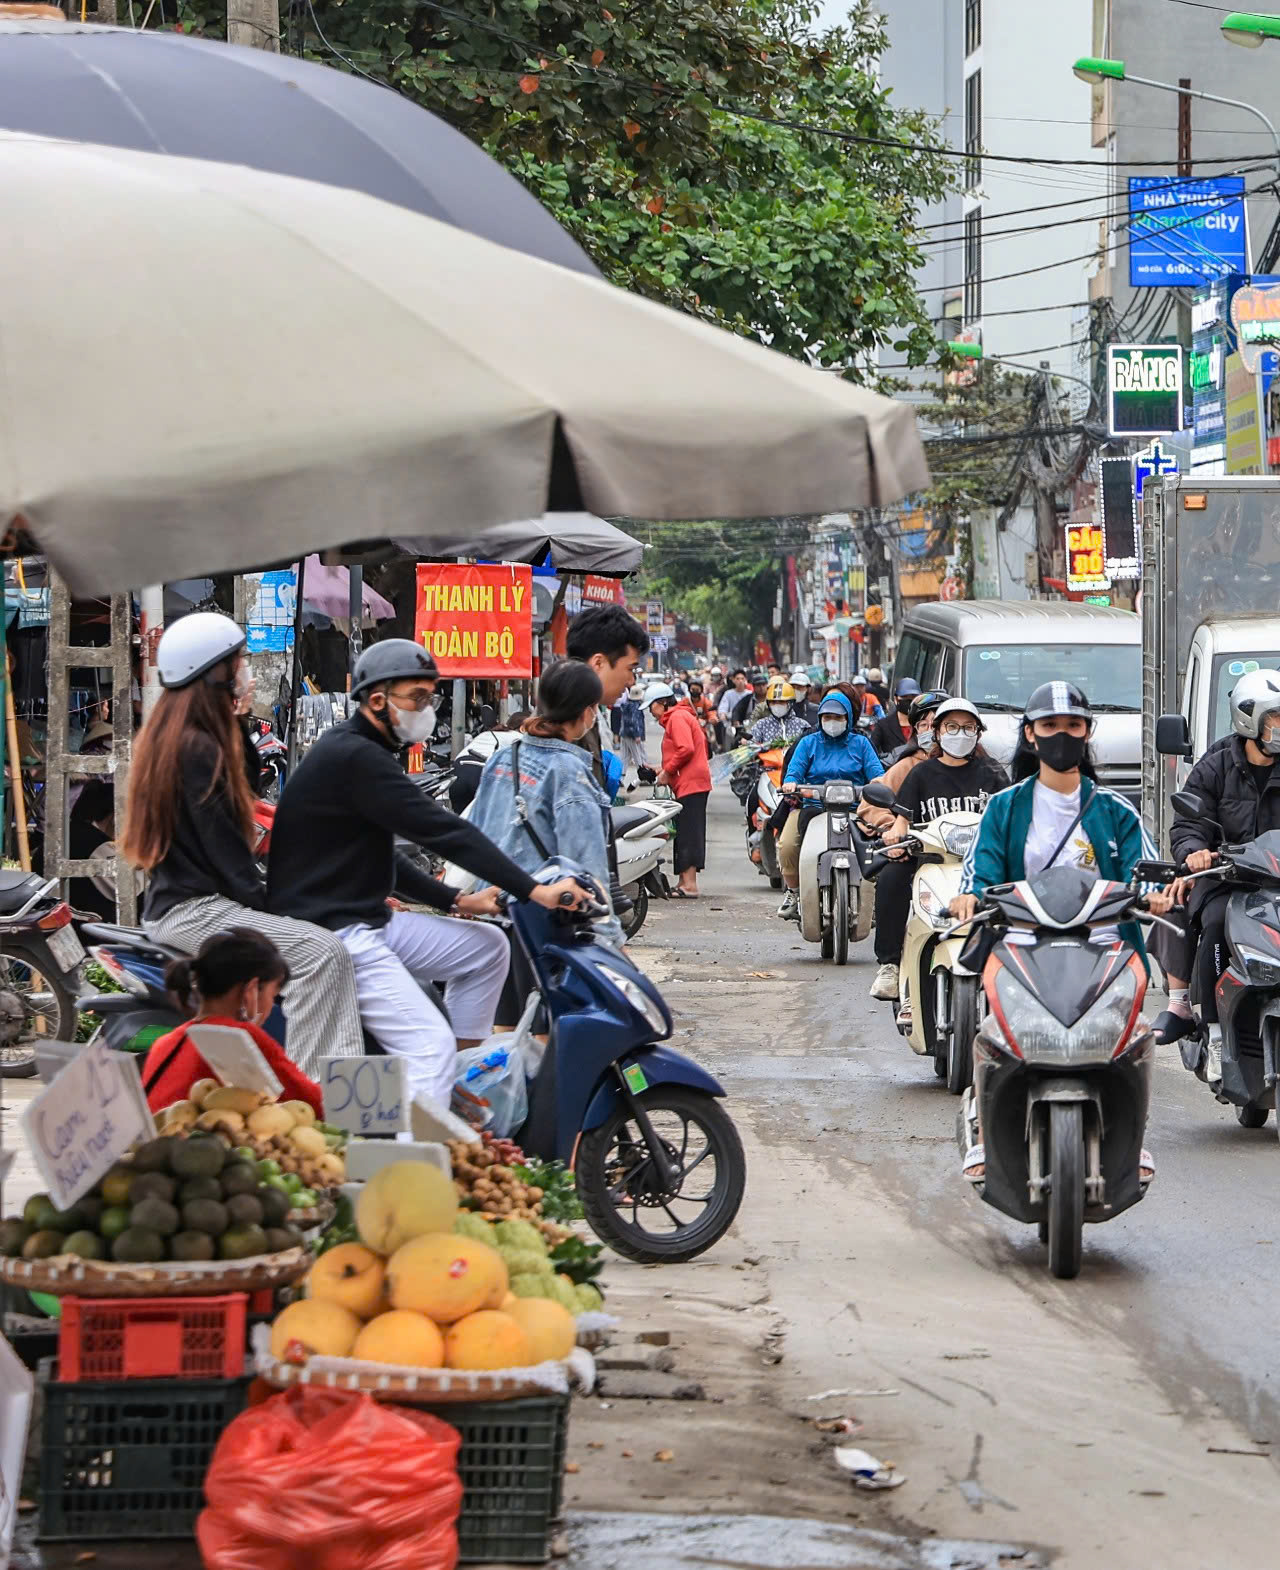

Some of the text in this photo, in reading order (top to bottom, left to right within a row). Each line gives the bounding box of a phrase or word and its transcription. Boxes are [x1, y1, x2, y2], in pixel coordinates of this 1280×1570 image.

[1144, 192, 1175, 206] NHÀ
[1110, 351, 1179, 392] RĂNG
[424, 582, 525, 612] THANH LÝ
[586, 585, 615, 601] KHÓA
[421, 626, 515, 664] TOÀN BỘ
